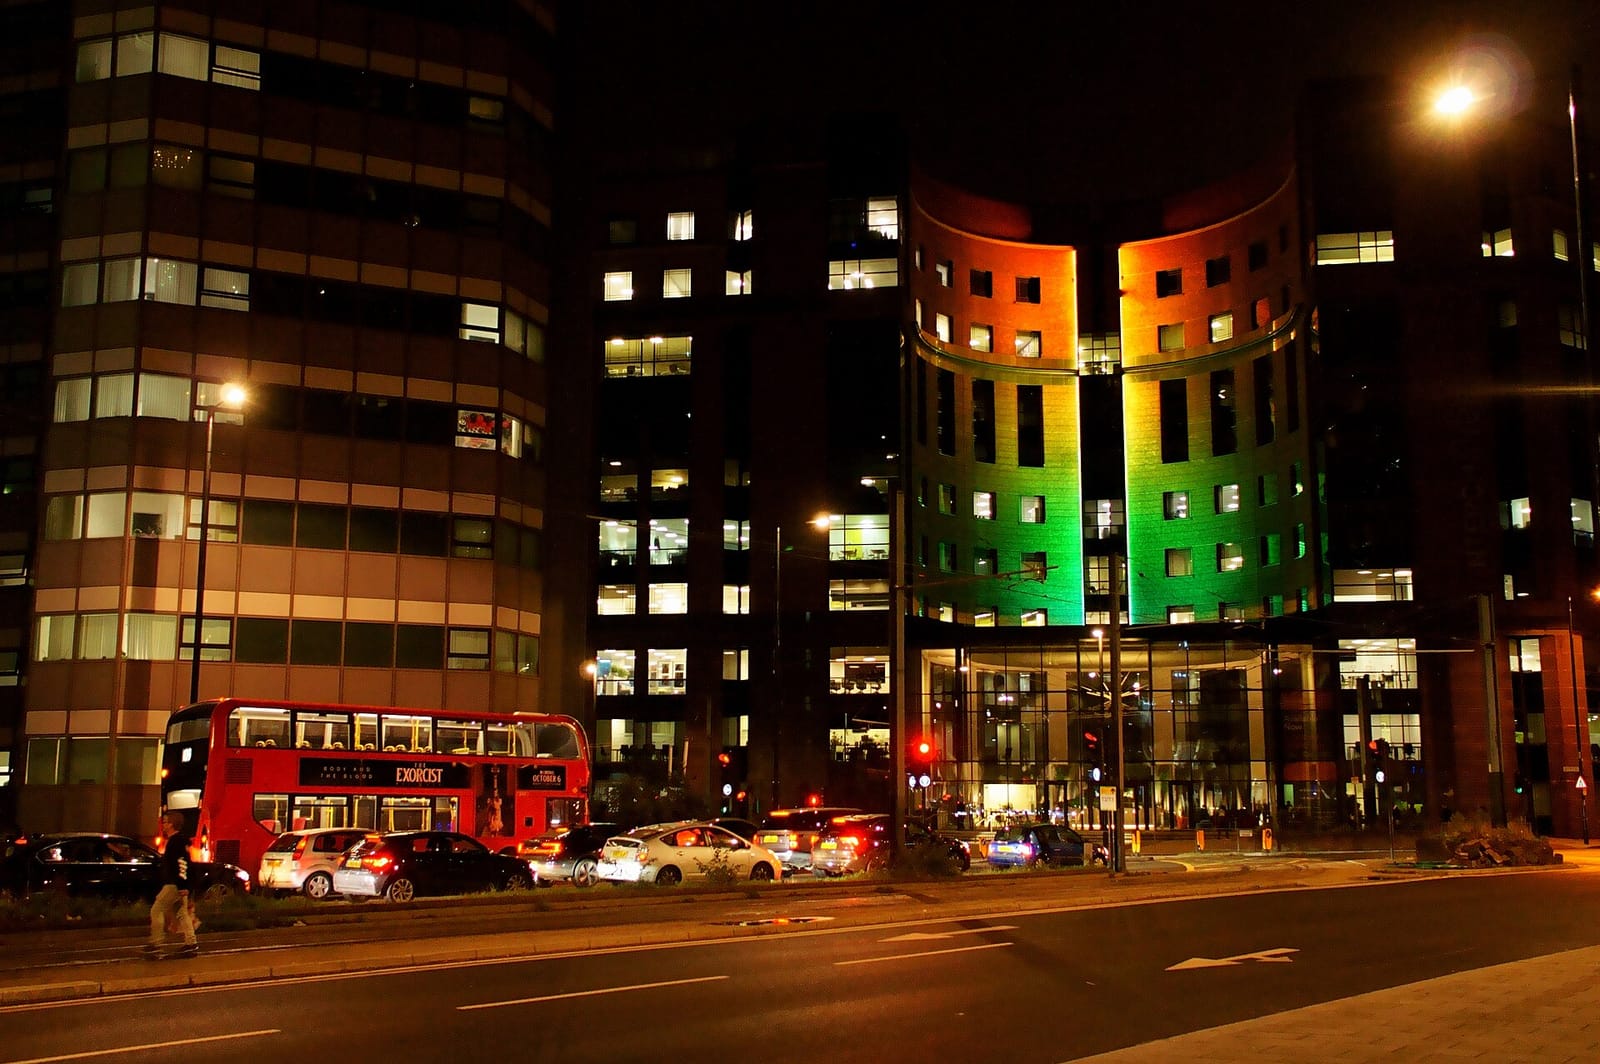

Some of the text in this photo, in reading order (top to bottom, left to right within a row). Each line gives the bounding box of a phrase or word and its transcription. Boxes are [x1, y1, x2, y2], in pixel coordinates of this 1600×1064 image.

[396, 767, 443, 783] EXORCIST
[532, 774, 562, 783] OCTOBER 6
